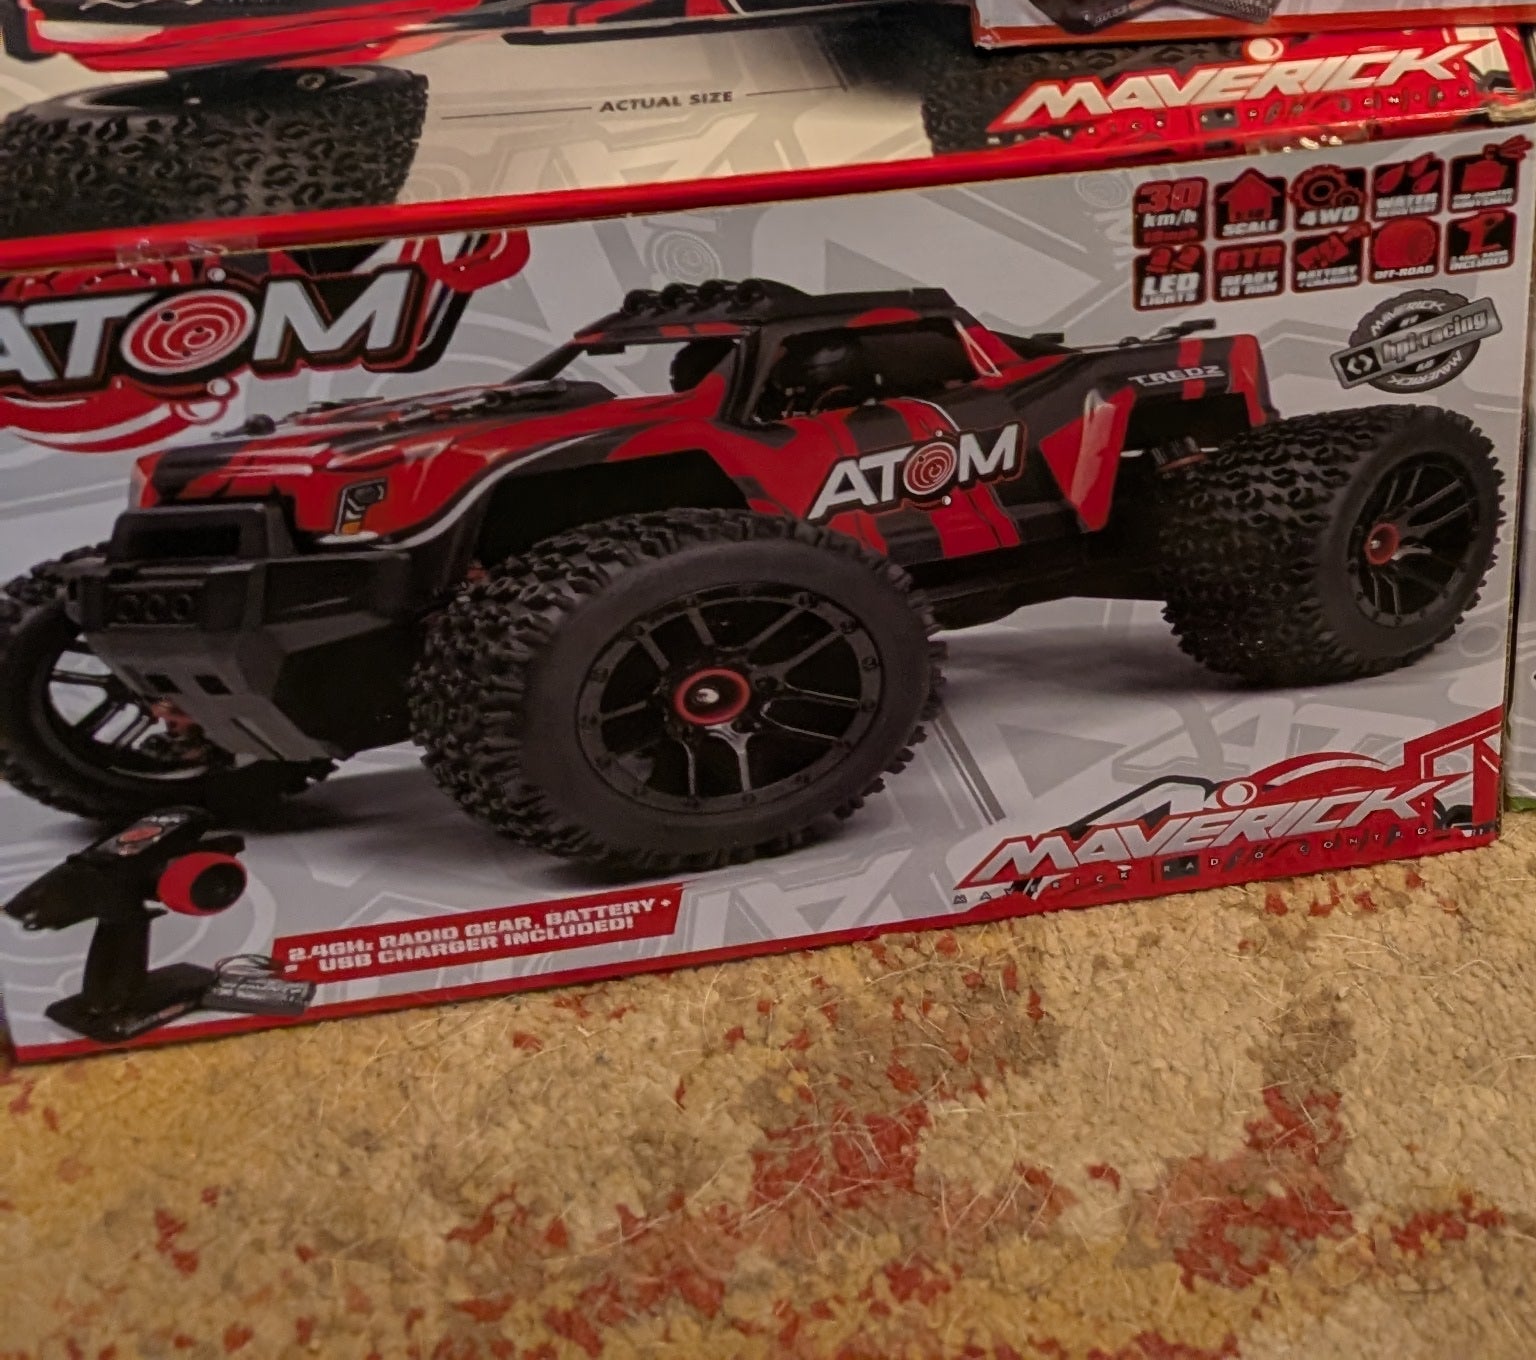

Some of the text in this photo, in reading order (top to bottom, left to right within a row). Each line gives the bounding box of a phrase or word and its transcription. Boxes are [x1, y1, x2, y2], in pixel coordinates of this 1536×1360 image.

[600, 91, 733, 112] ACTUAL SIZE
[1003, 44, 1472, 124] MAVERICK
[1138, 181, 1204, 213] 30
[1300, 205, 1360, 227] 4WD
[1143, 209, 1198, 228] km/h
[1143, 272, 1200, 296] LED
[808, 424, 1018, 520] ATOM
[976, 779, 1447, 882] MAVERICK
[318, 915, 634, 973] USB CHARGER INCLUDED!
[379, 927, 459, 950] RADIO
[545, 898, 656, 927] BATTERY
